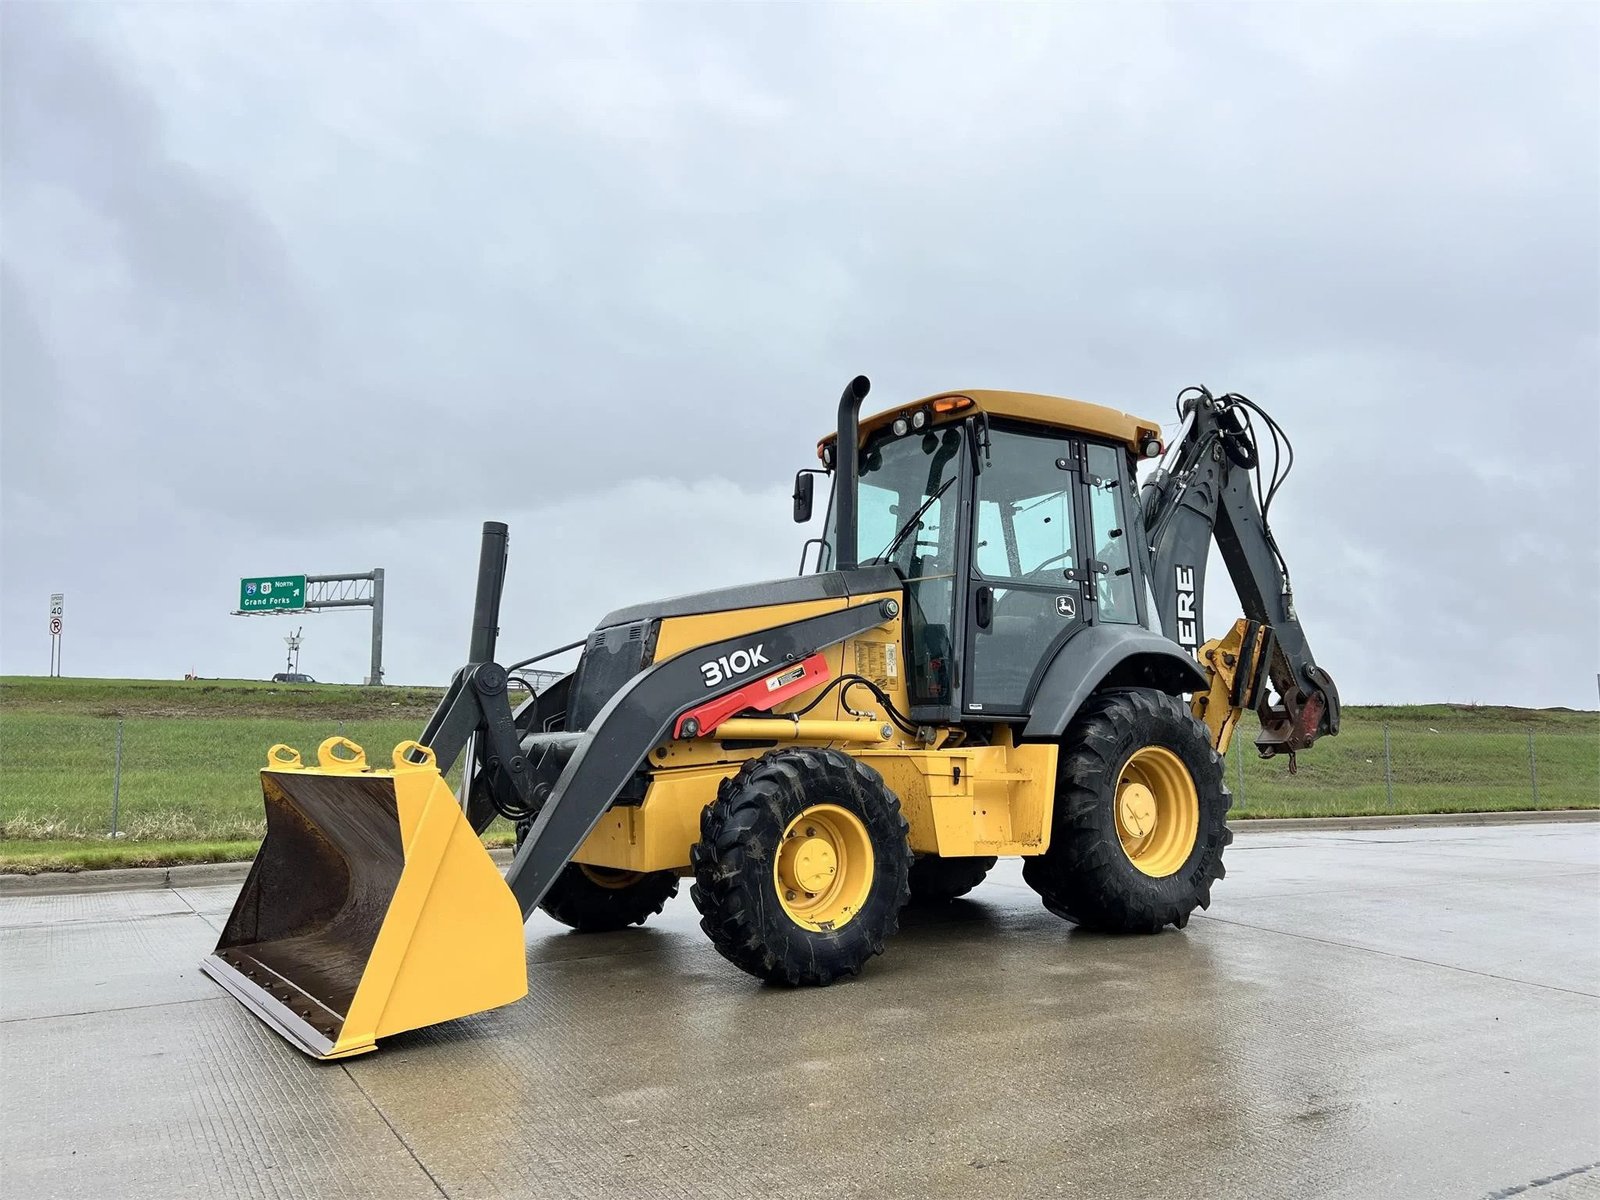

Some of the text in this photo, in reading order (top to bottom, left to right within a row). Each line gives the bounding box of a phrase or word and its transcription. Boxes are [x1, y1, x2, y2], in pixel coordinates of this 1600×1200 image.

[247, 585, 256, 594] 29
[244, 597, 290, 606] Grand Forks
[51, 607, 62, 615] 40
[1176, 566, 1198, 662] ERE
[701, 644, 769, 687] 310K
